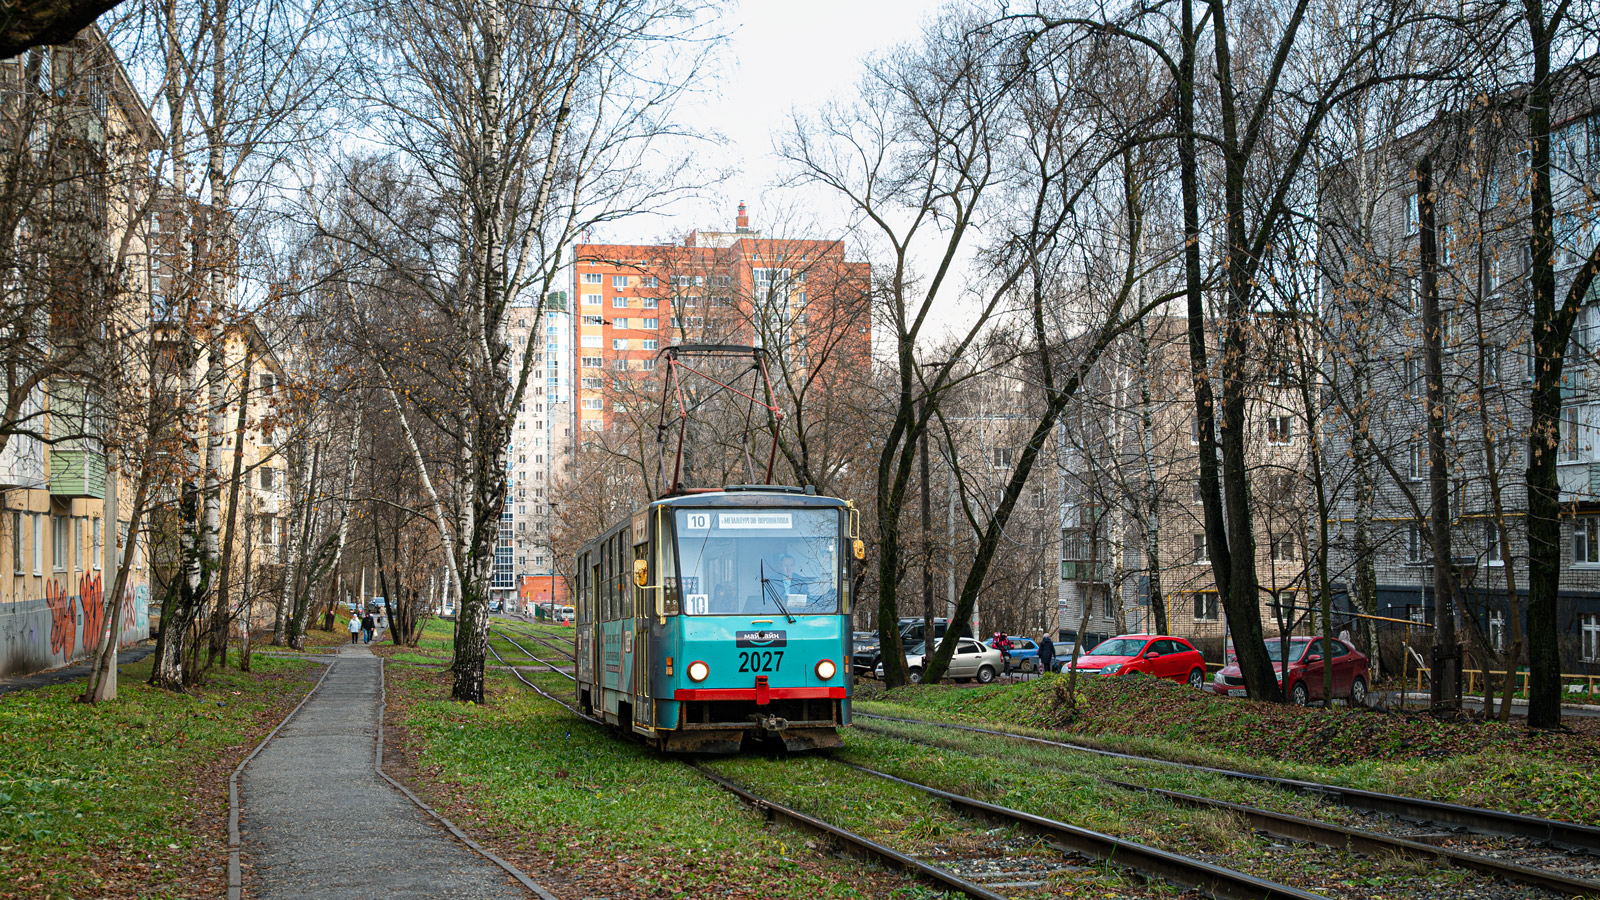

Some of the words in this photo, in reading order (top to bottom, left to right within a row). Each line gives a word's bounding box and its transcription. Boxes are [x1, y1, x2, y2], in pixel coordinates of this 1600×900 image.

[691, 515, 705, 528] 10
[691, 596, 705, 615] 10
[743, 631, 780, 640] майайн
[738, 650, 785, 673] 2027
